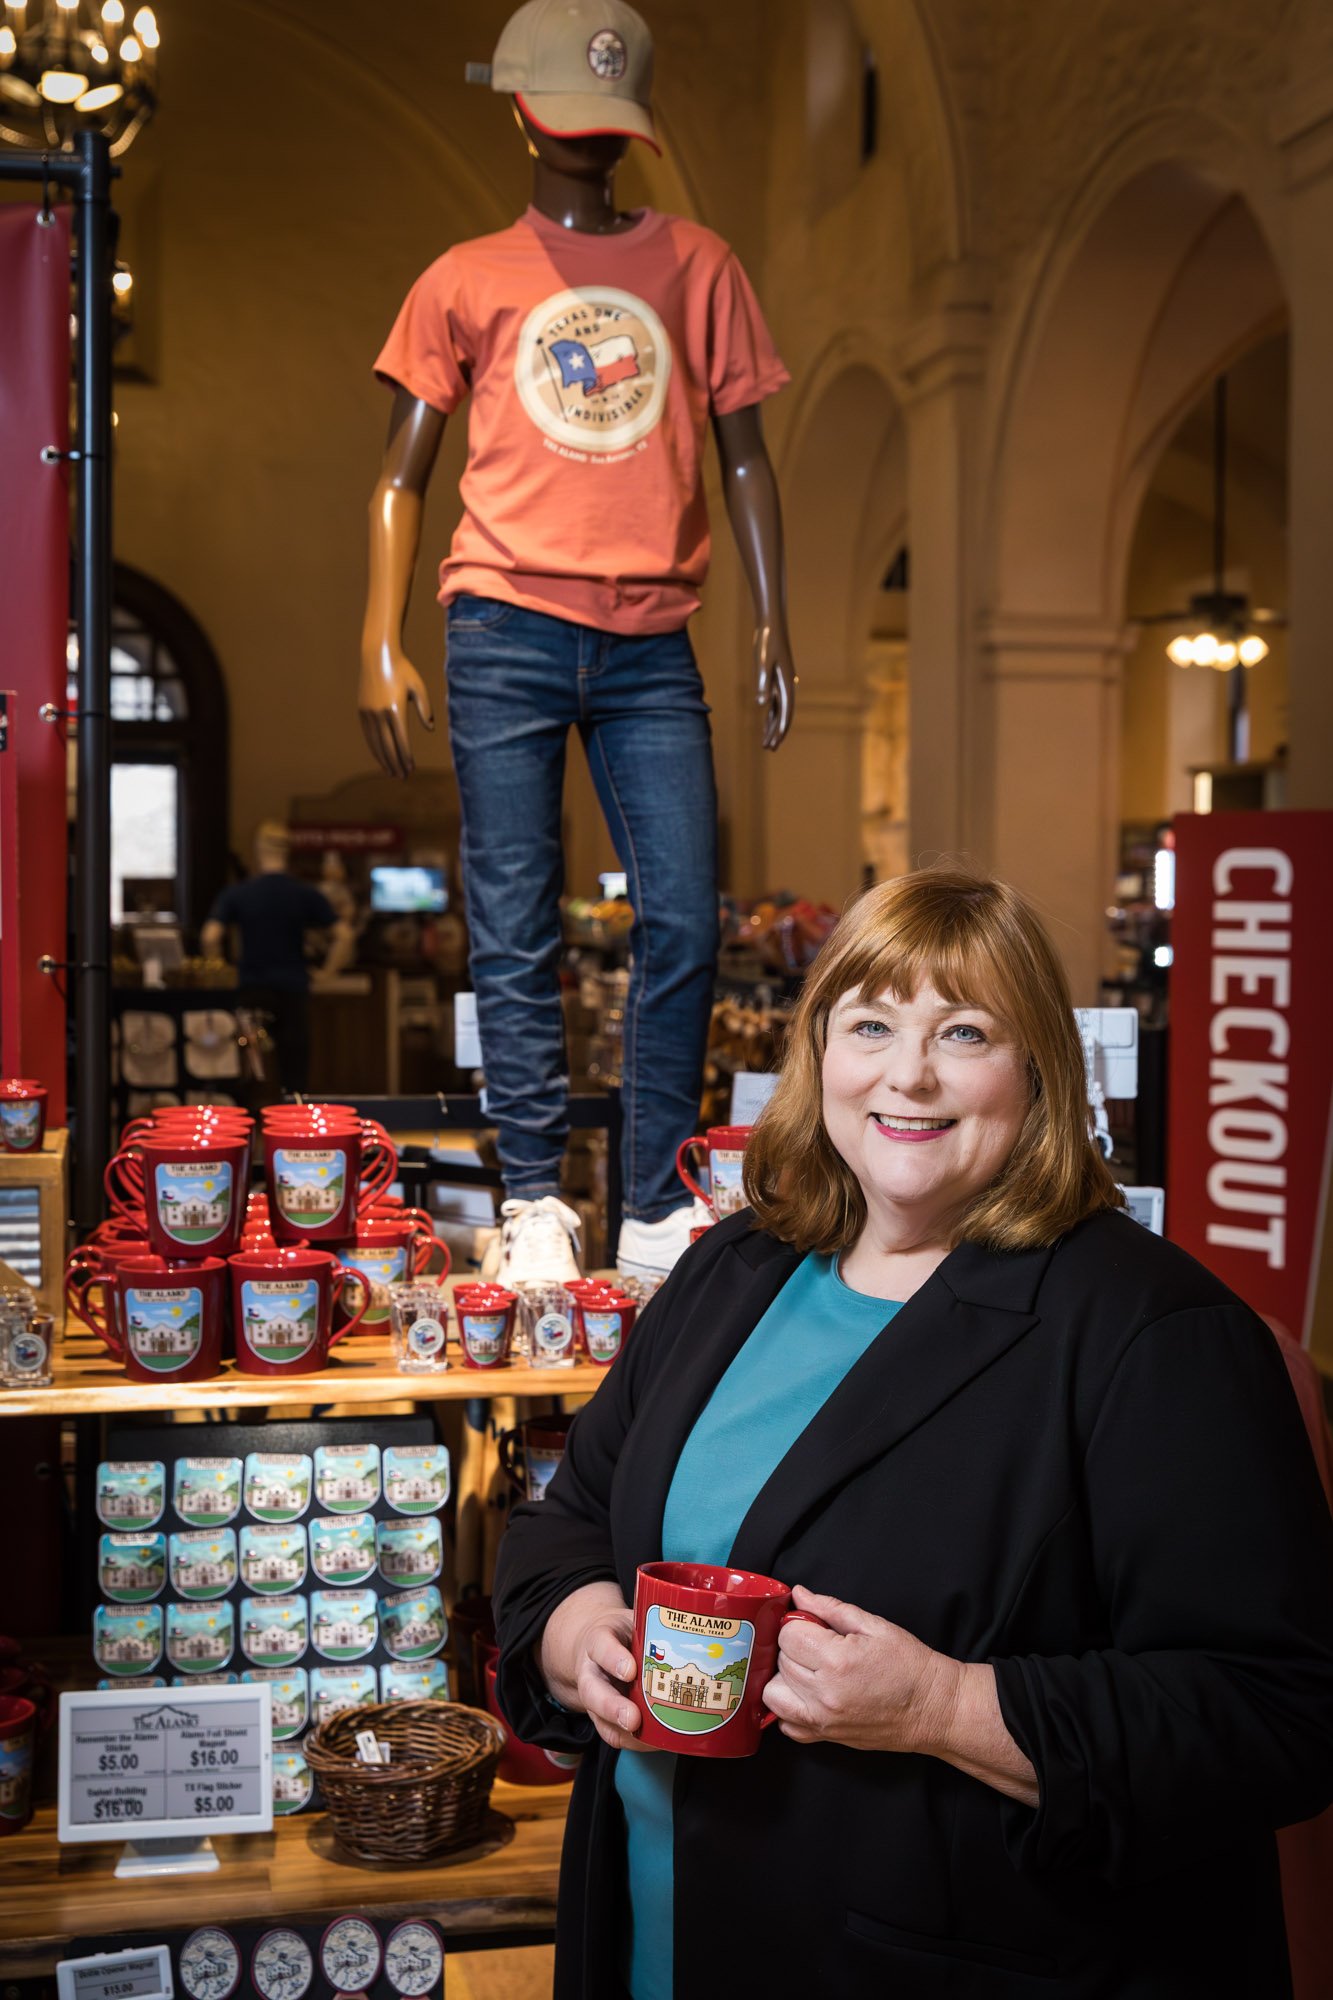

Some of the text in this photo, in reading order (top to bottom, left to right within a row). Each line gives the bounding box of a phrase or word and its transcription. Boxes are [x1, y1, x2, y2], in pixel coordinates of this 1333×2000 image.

[549, 309, 588, 337] TEXAS
[575, 323, 600, 337] AND
[567, 388, 643, 423] INDIVISIBLE
[1206, 847, 1294, 1269] CHECKOUT
[189, 1164, 218, 1172] ALAMO
[257, 1281, 303, 1290] THE ALAMO
[139, 1290, 186, 1298] THE ALAMO
[667, 1610, 732, 1630] THE ALAMO
[682, 1625, 706, 1634] ANTONIO,
[154, 1715, 199, 1729] ALAMO
[76, 1735, 116, 1744] Remember
[134, 1733, 158, 1741] Alamo
[105, 1744, 131, 1752] Sticker
[99, 1753, 138, 1771] $5.00
[191, 1749, 239, 1767] $16.00
[197, 1782, 214, 1792] Flag
[216, 1781, 242, 1790] Sticker
[94, 1799, 143, 1818] $16.00
[195, 1795, 234, 1813] $5.00
